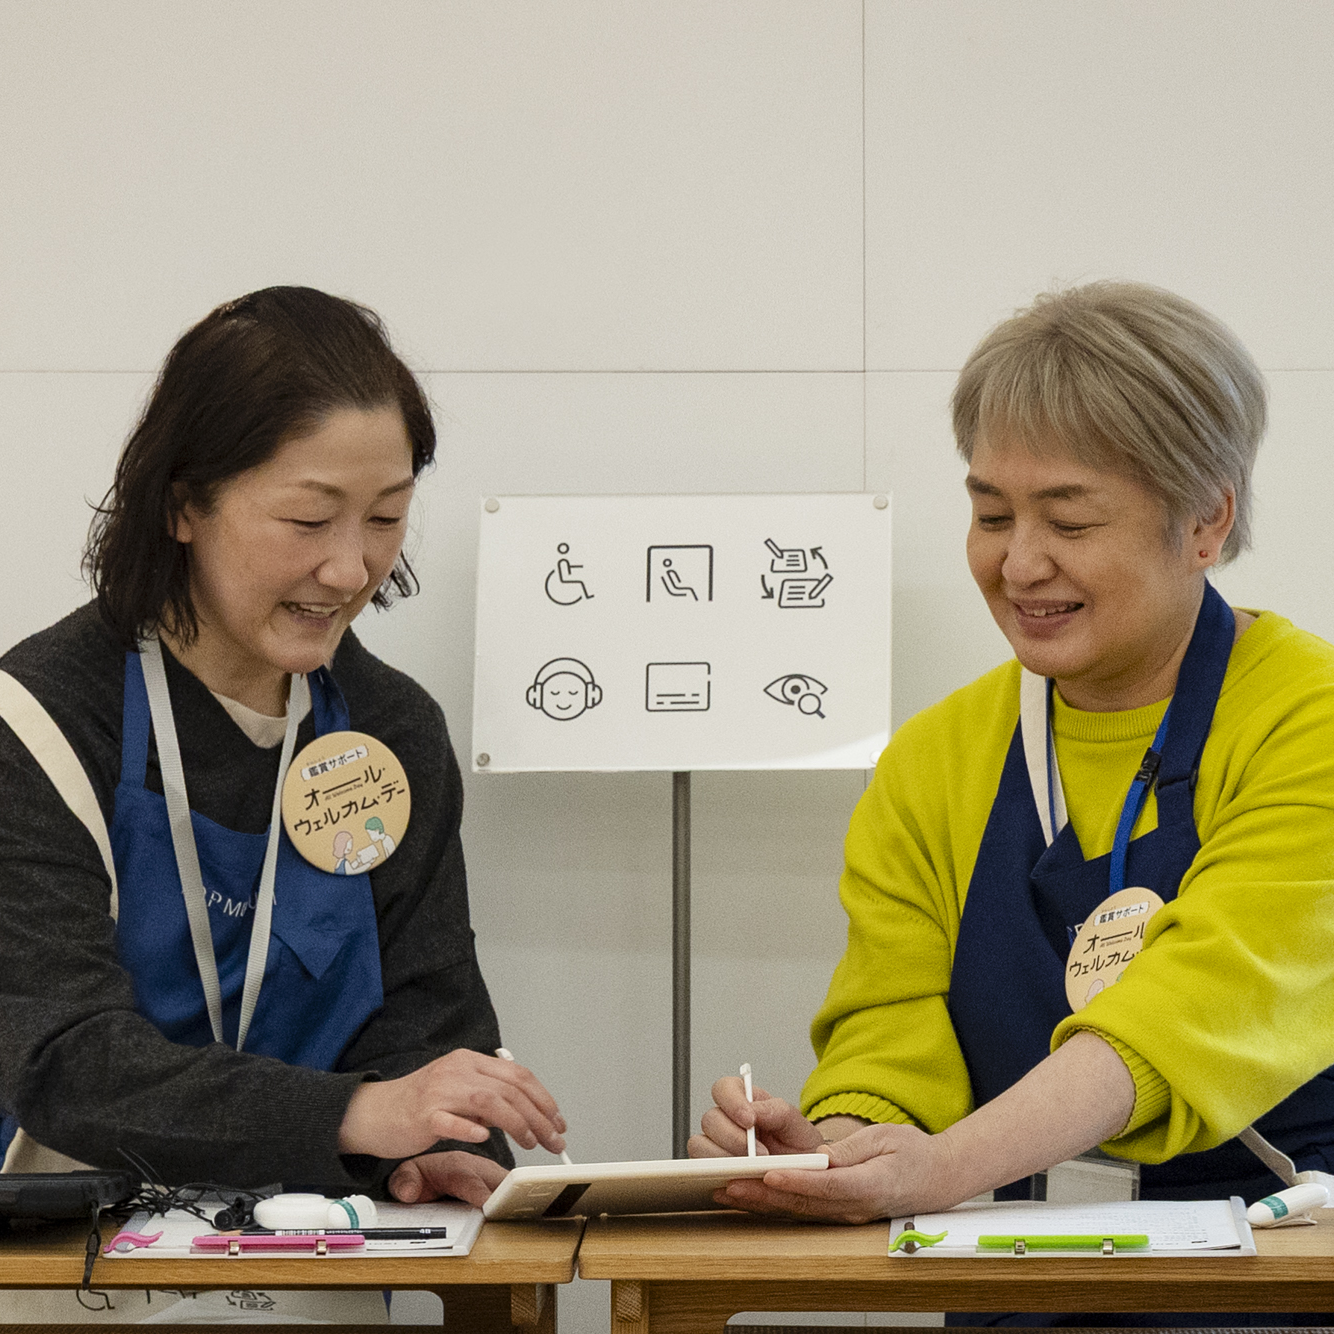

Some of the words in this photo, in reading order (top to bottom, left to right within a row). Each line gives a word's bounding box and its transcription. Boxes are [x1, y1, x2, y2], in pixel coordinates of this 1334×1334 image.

[308, 749, 363, 777] 鑑賞サポート
